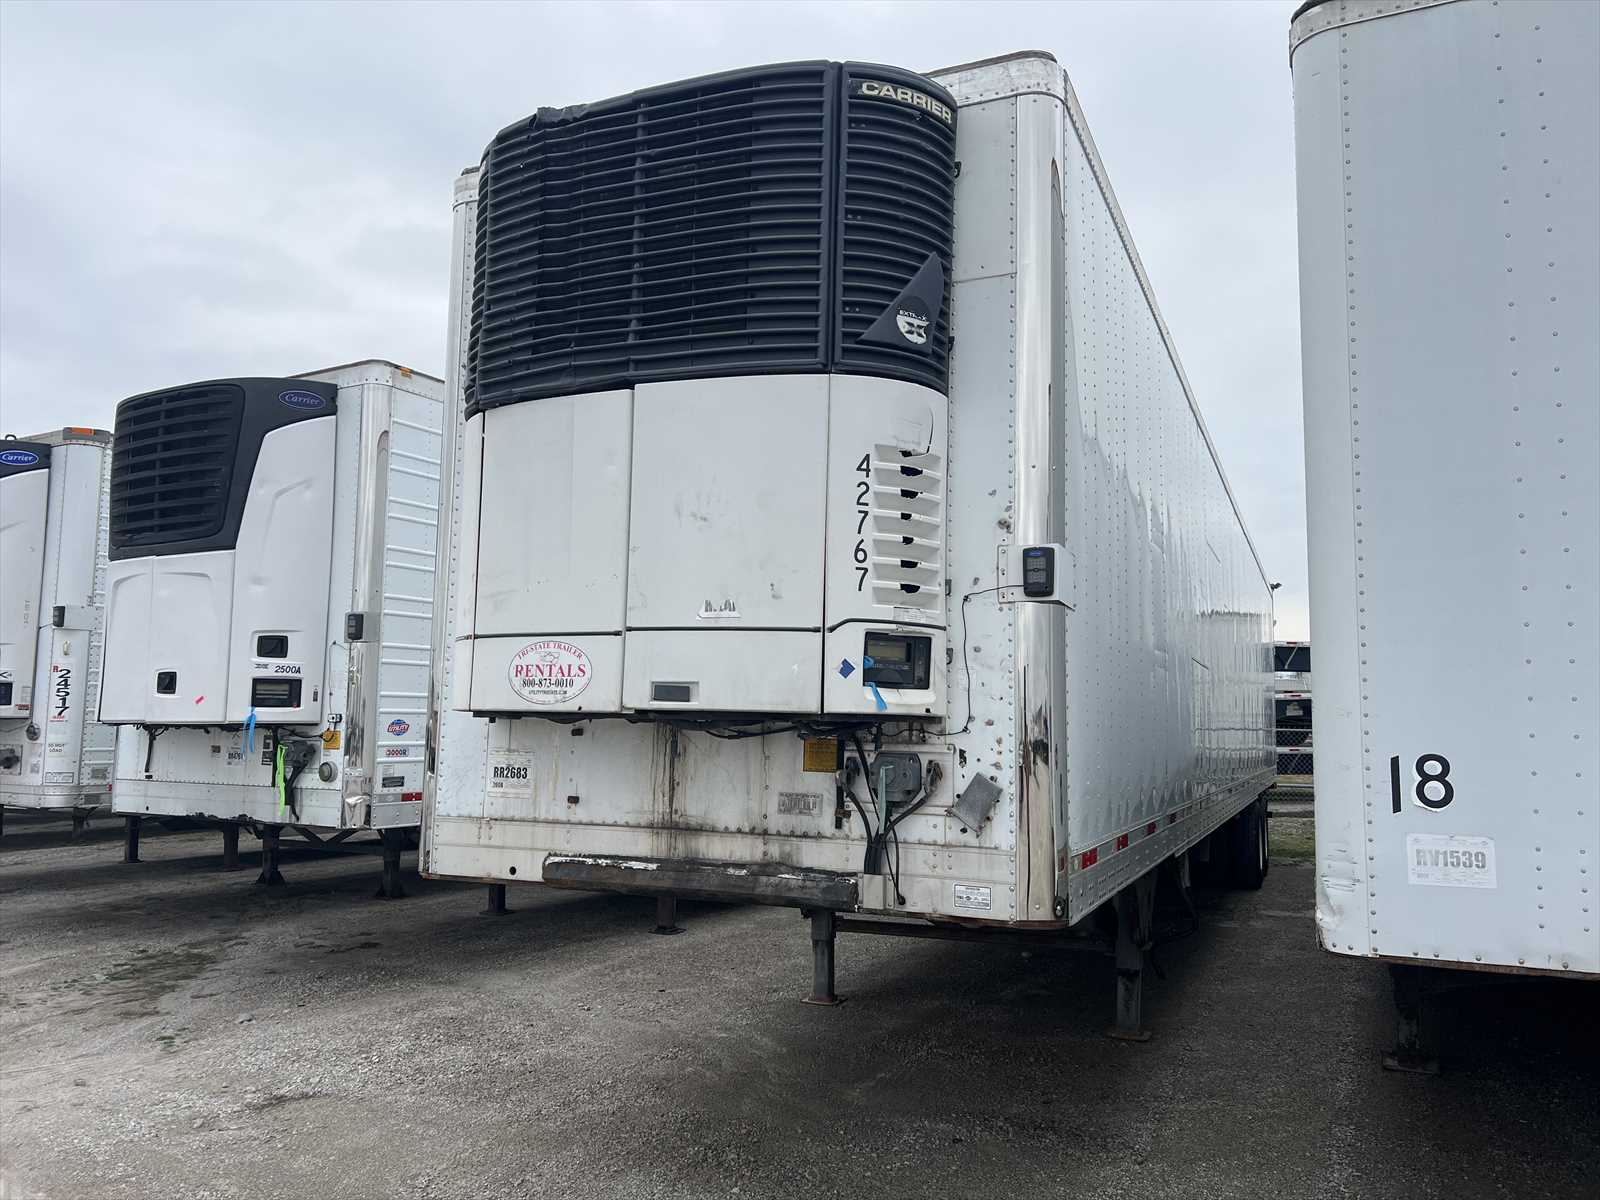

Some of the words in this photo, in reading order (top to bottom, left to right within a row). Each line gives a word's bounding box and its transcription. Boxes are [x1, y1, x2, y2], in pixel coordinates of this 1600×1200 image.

[861, 81, 952, 124] CARRIER
[284, 393, 321, 405] Carrier
[1, 453, 34, 462] Carrier
[853, 453, 872, 592] 42767
[553, 642, 583, 661] TRAILER
[274, 665, 302, 674] 2500A
[514, 663, 587, 678] RENTALS
[522, 678, 575, 689] 800-873-0010
[493, 766, 529, 779] RR2683
[1390, 753, 1455, 814] 18
[1415, 848, 1487, 870] RV1539
